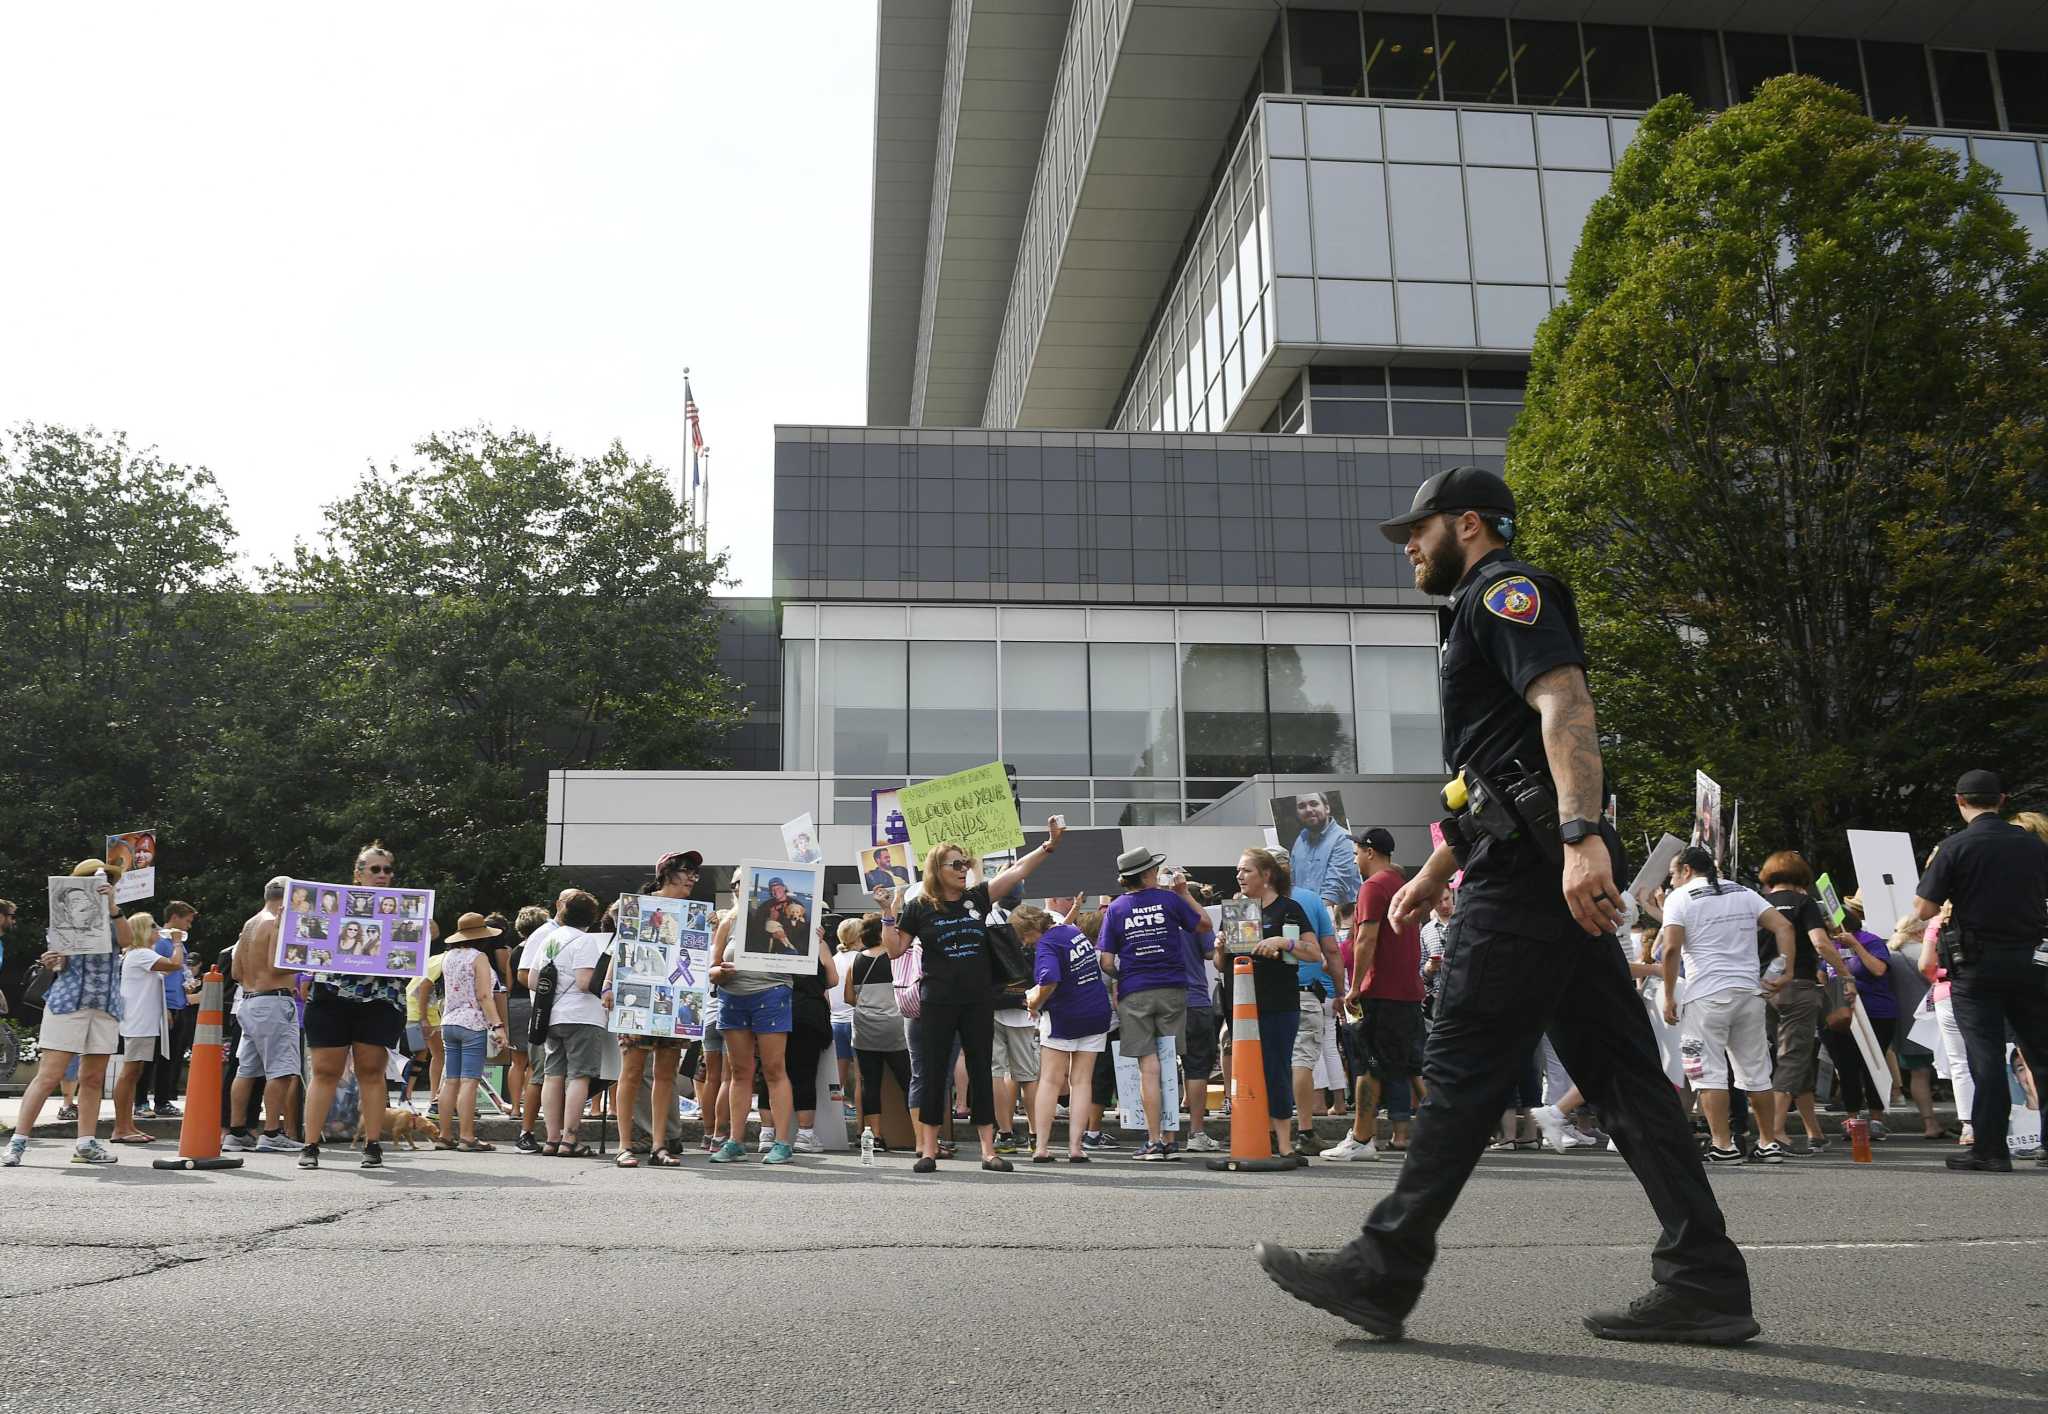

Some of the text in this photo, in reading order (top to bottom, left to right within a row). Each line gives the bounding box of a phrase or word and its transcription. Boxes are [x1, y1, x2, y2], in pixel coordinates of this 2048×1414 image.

[907, 800, 953, 826] BLOOD
[954, 793, 973, 812] ON
[975, 784, 1006, 806] YOUR
[925, 813, 987, 845] HANDS
[1125, 913, 1165, 929] ACTS
[1132, 904, 1163, 914] NATICK
